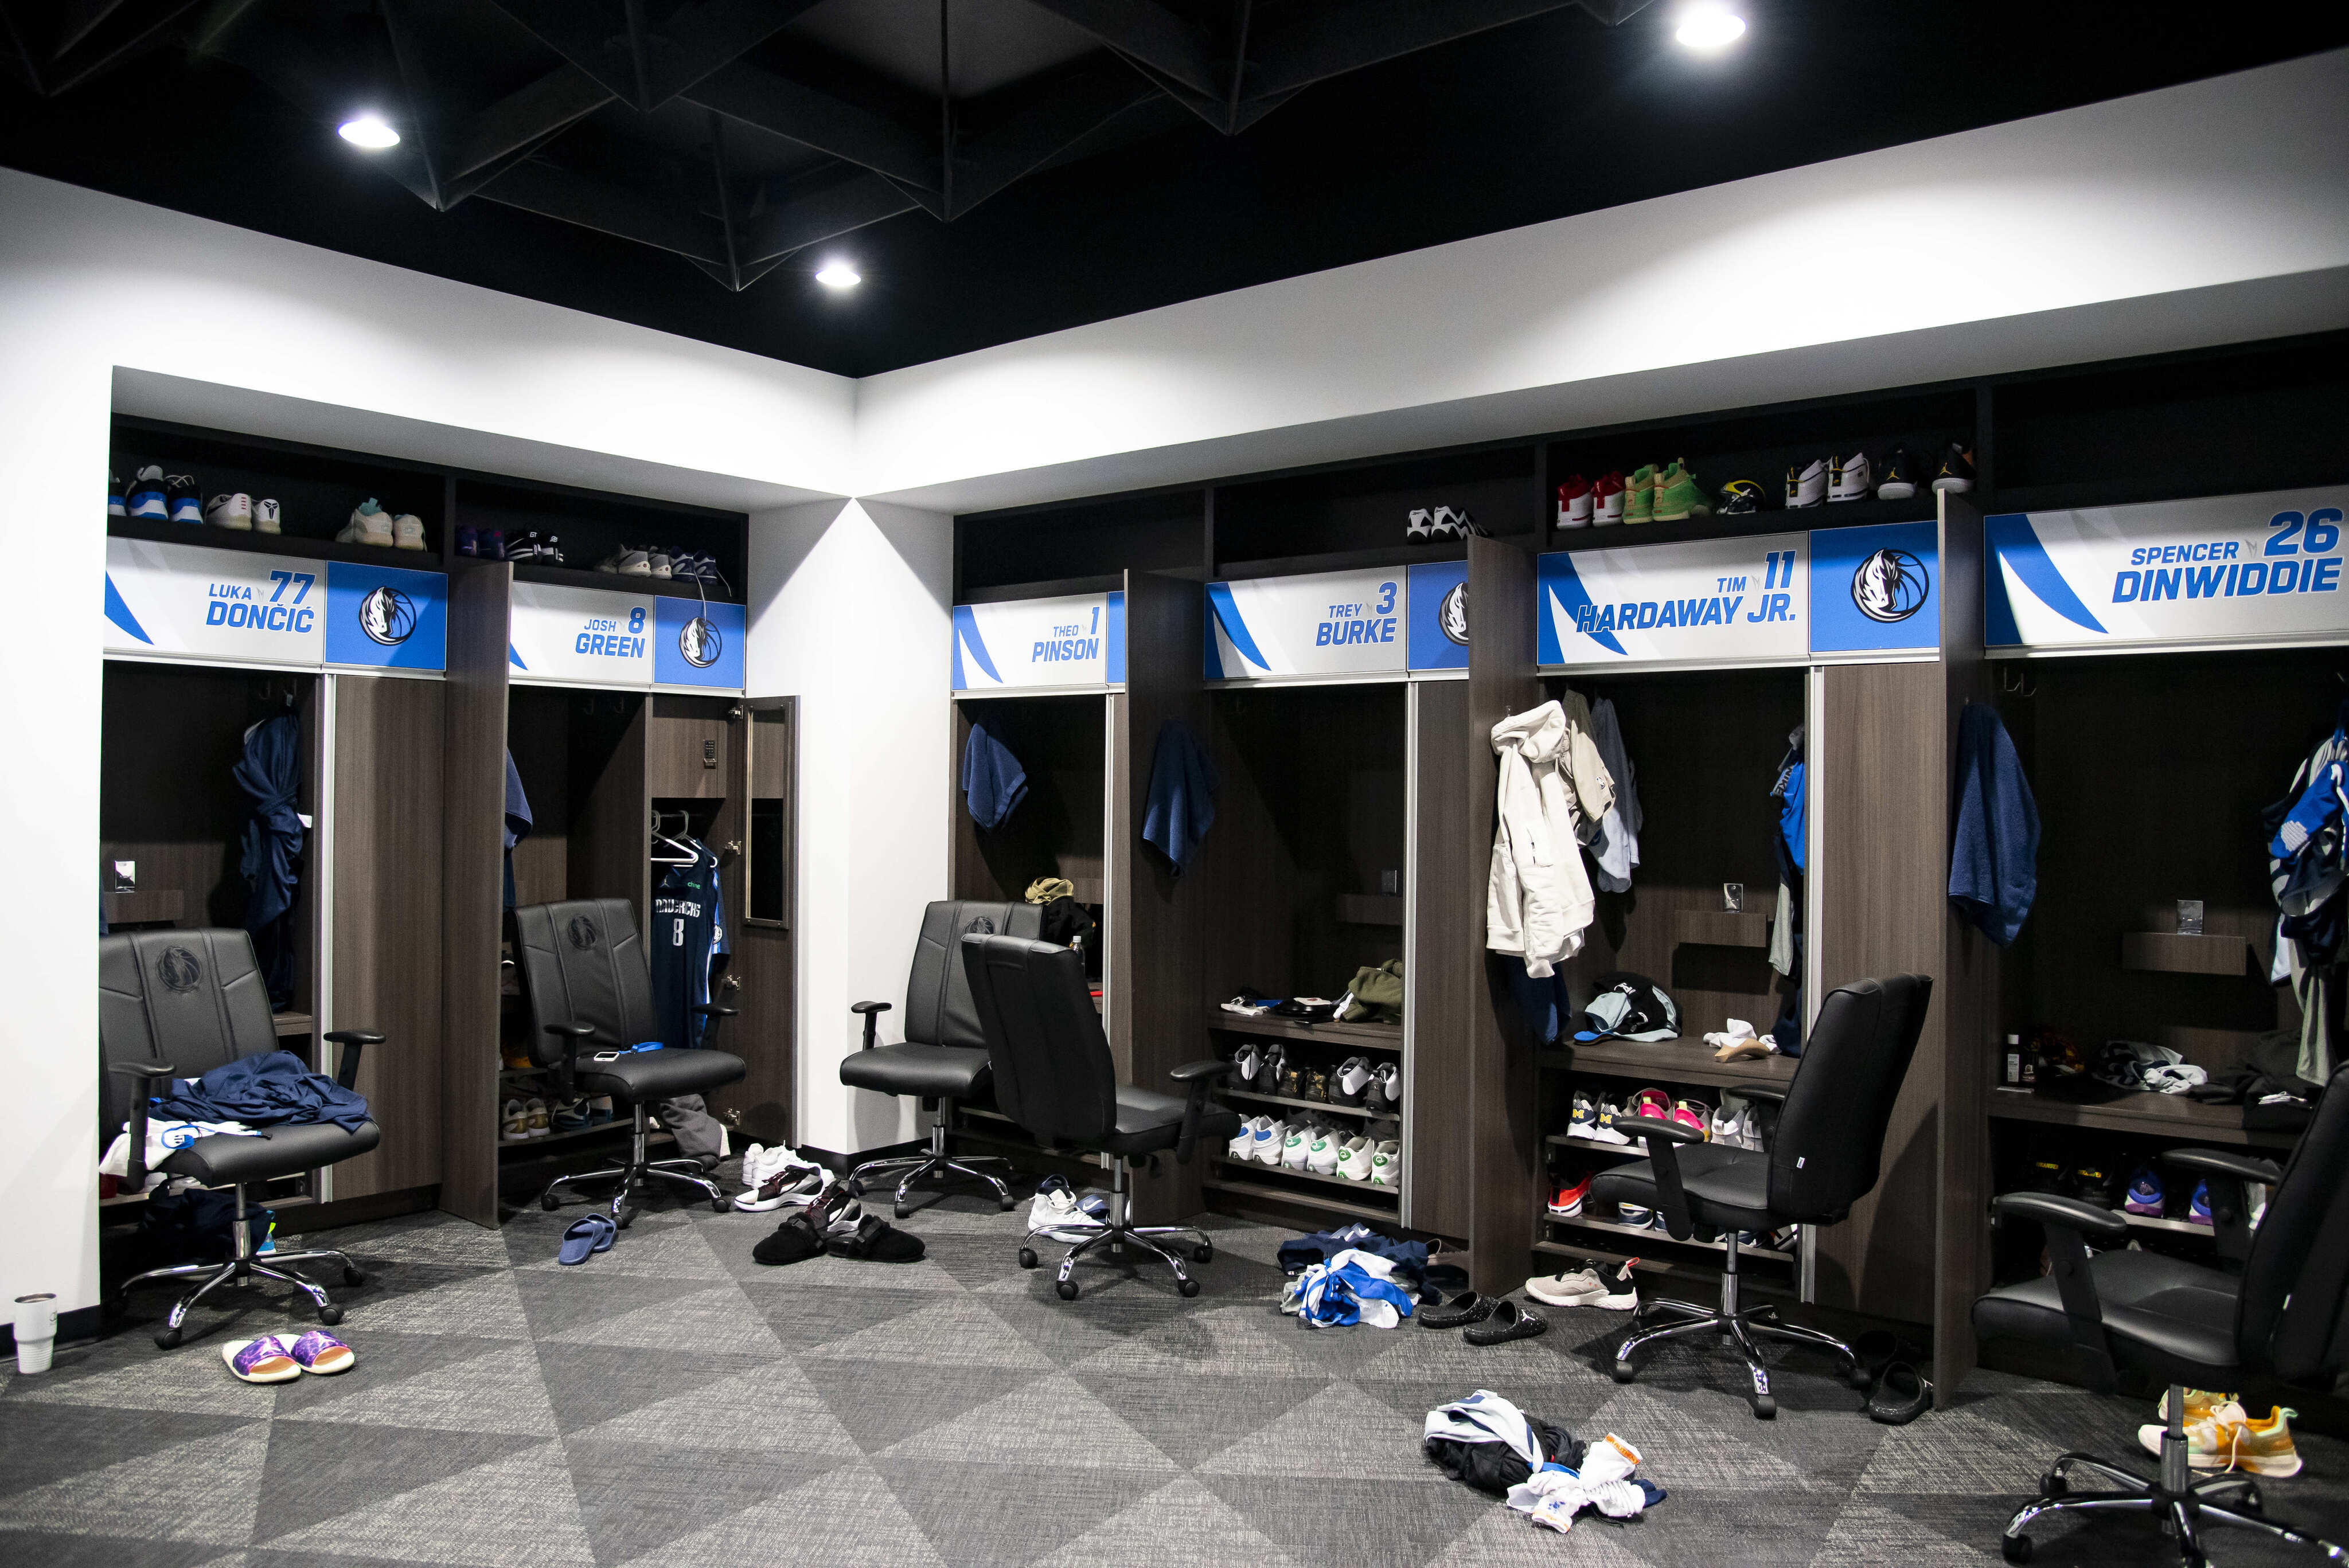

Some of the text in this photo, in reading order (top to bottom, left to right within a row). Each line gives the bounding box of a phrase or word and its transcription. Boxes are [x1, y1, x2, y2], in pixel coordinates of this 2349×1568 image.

[2131, 507, 2343, 566] SPENCER 26
[208, 570, 315, 605] LUKA 77
[1717, 551, 1795, 593] TIM 11
[2112, 557, 2343, 603] DINWIDDIE
[1329, 582, 1398, 618] TREY 3
[1575, 593, 1797, 634] HARDAWAY JR.
[206, 601, 314, 634] DONČIĆ
[584, 607, 646, 634] JOSH 8
[1053, 606, 1100, 638] THEO 1
[1316, 618, 1397, 646] BURKE
[575, 632, 646, 658] GREEN
[1032, 638, 1099, 663] PINSON
[1775, 765, 1793, 796] NIKE
[673, 918, 684, 947] 8
[1572, 1108, 1585, 1119] M
[1599, 1113, 1612, 1124] M
